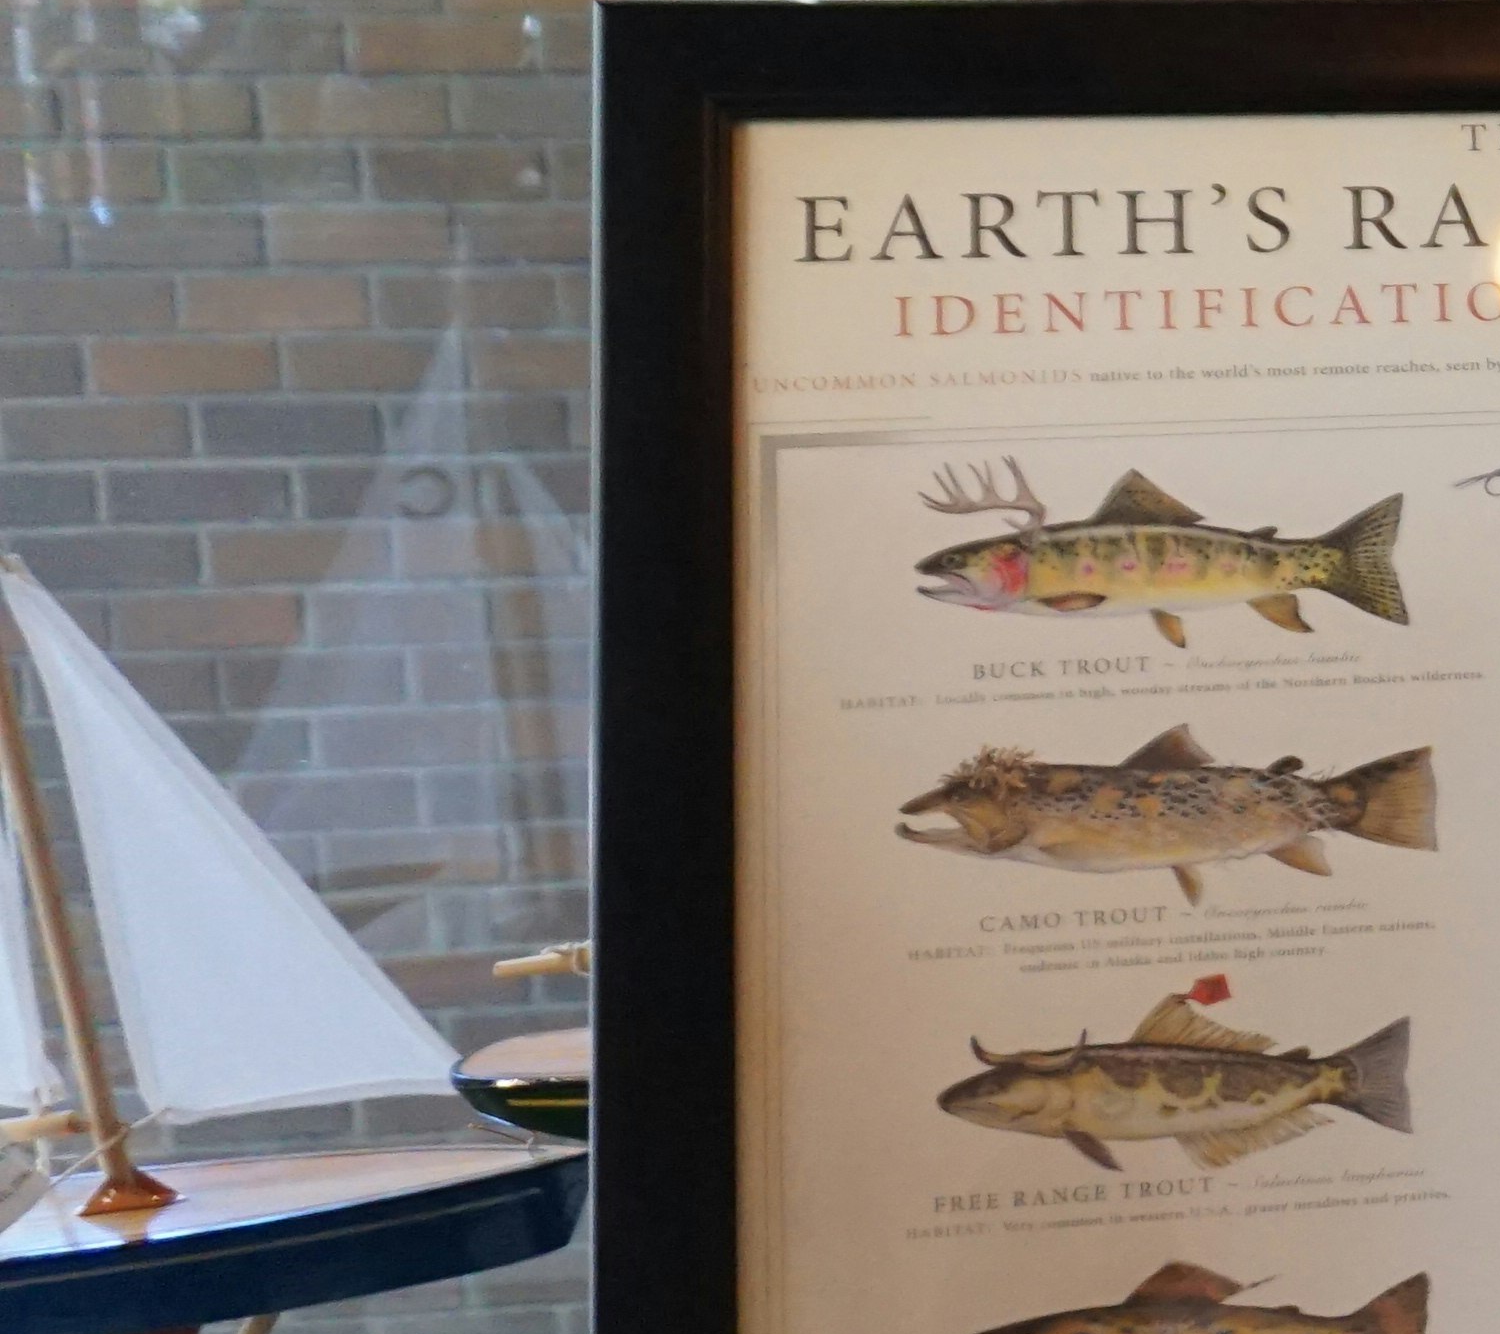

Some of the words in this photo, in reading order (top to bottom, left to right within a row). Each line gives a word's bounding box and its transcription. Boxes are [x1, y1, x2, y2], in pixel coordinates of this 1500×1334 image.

[793, 183, 1292, 263] EARTH'S
[752, 372, 916, 394] UNCOMMON
[929, 367, 1082, 386] SALMONIDS
[1088, 368, 1140, 382] native
[1146, 367, 1163, 380] to
[1169, 365, 1196, 380] the
[1201, 364, 1261, 379] world's
[1266, 364, 1306, 377] most
[1312, 363, 1370, 376] remote
[1376, 359, 1441, 375] reaches,
[1446, 360, 1481, 373] seen
[971, 660, 1046, 680] BUCK
[1058, 655, 1152, 677] TROUT
[978, 910, 1061, 933] CAMO
[1073, 906, 1168, 927] TROUT
[933, 1194, 1001, 1215] FREE
[1013, 1185, 1106, 1208] RANGE
[1121, 1177, 1215, 1200] TROUT
